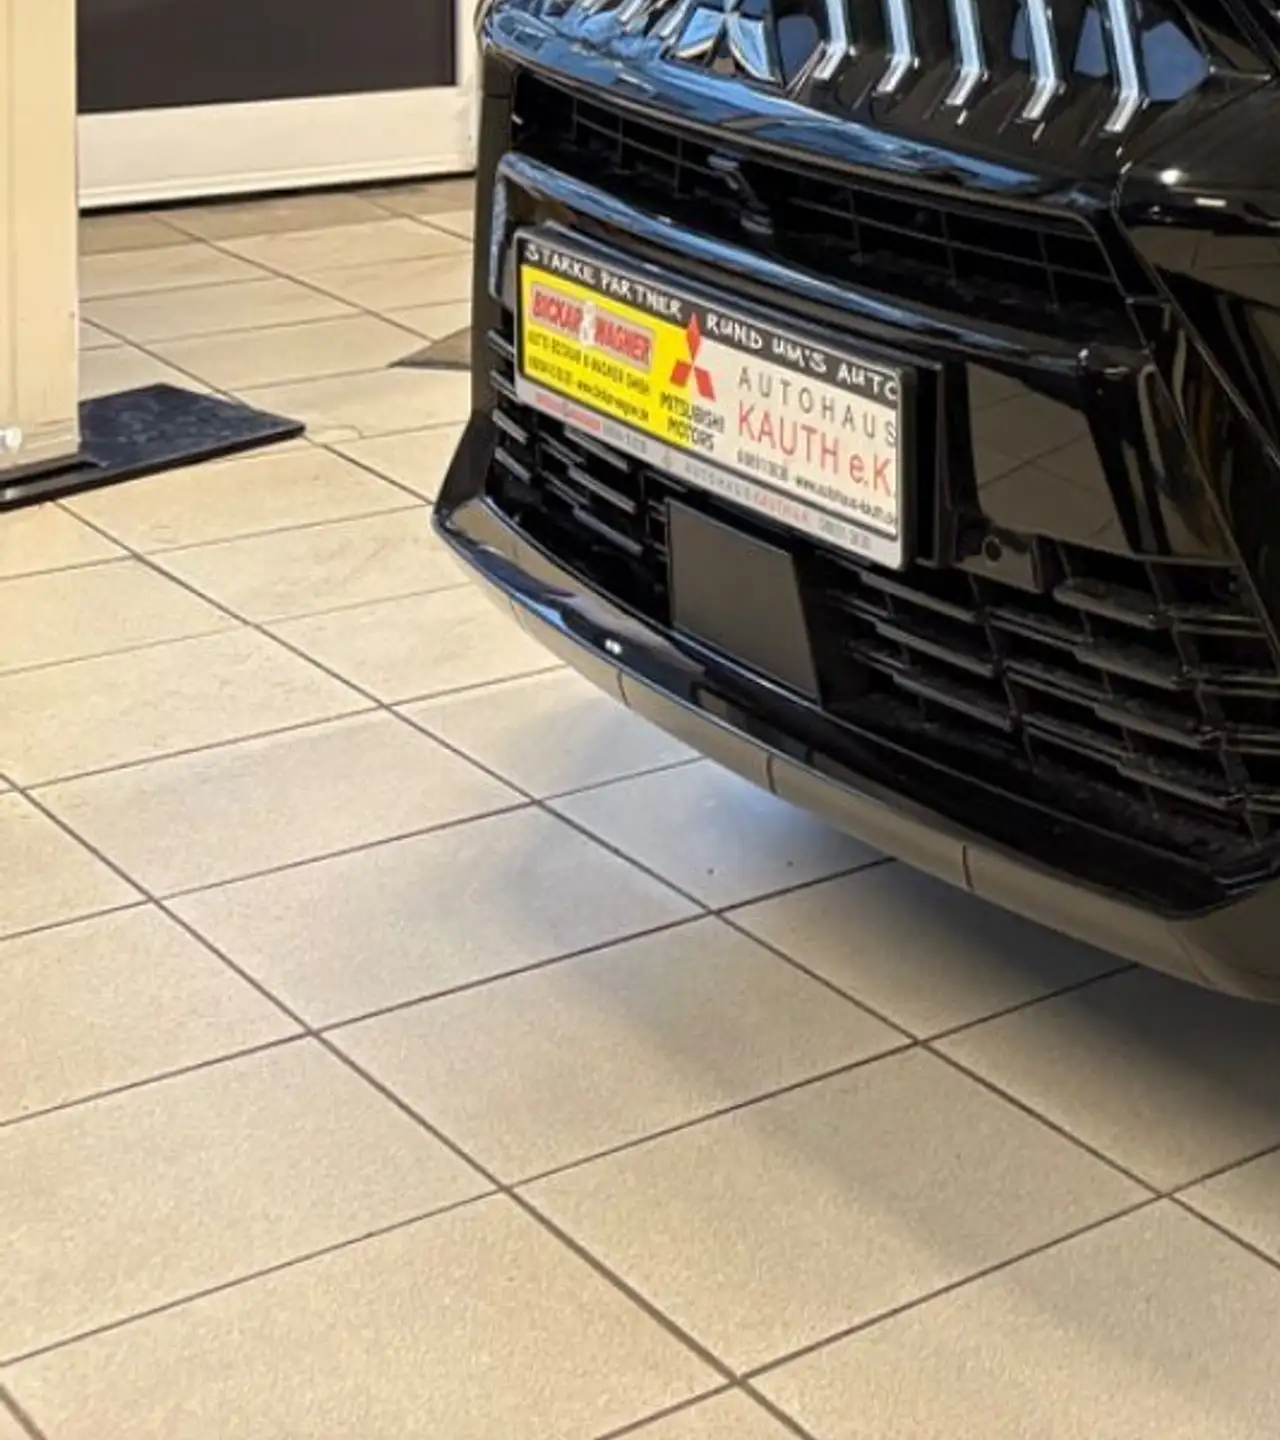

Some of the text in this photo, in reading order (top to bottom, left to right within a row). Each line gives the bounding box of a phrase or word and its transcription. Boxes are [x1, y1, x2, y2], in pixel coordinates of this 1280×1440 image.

[525, 242, 597, 285] STARKE
[601, 270, 683, 320] PARTNER
[706, 313, 763, 351] RUND
[772, 337, 828, 375] UM'S
[659, 390, 725, 433] MITSUBISHI
[667, 416, 715, 451] MOTORS
[737, 366, 898, 445] AUTOHAUS
[737, 400, 840, 476] KAUTH
